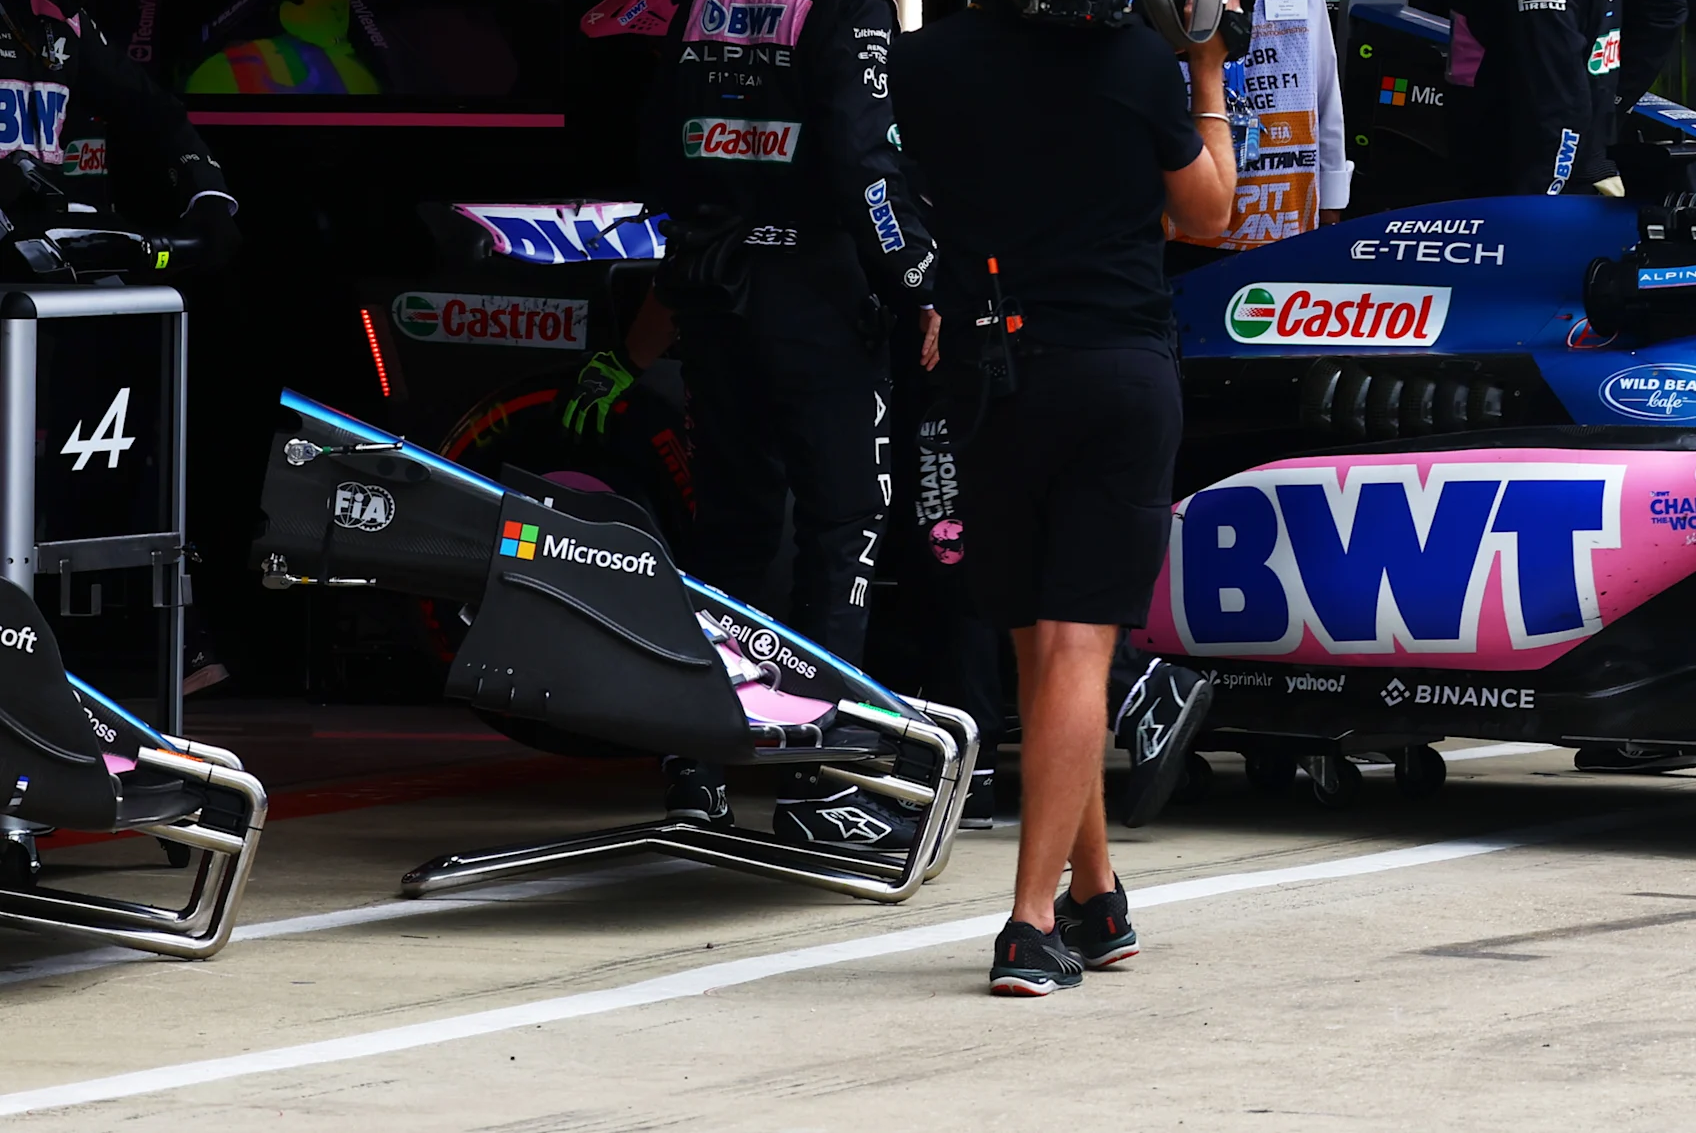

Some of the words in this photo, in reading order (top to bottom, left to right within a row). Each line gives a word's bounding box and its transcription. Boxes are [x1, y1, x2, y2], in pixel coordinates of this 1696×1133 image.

[724, 3, 788, 38] BWT
[679, 46, 792, 67] ALPINE
[863, 65, 889, 99] plug
[1245, 74, 1279, 93] EER
[1281, 73, 1299, 88] F1
[1246, 93, 1276, 111] AGE
[703, 123, 791, 158] Castrol
[1557, 128, 1580, 179] BWT
[79, 142, 106, 171] Cast
[1235, 182, 1291, 214] PIT
[869, 200, 906, 254] BWT
[1220, 210, 1300, 241] ANE
[1384, 219, 1485, 236] RENAULT
[1350, 239, 1505, 266] E-TECH
[442, 298, 577, 342] Castrol
[1275, 289, 1435, 341] Castrol
[1619, 378, 1660, 390] WILD
[848, 389, 893, 608] ALPNE
[1651, 516, 1668, 524] THE
[542, 535, 658, 577] Microsoft
[1176, 472, 1616, 649] BWT
[718, 614, 752, 644] Bell
[776, 647, 818, 680] Ross
[1223, 672, 1273, 688] sprinklr
[1285, 674, 1346, 693] yahoo!
[1414, 684, 1536, 709] BINANCE
